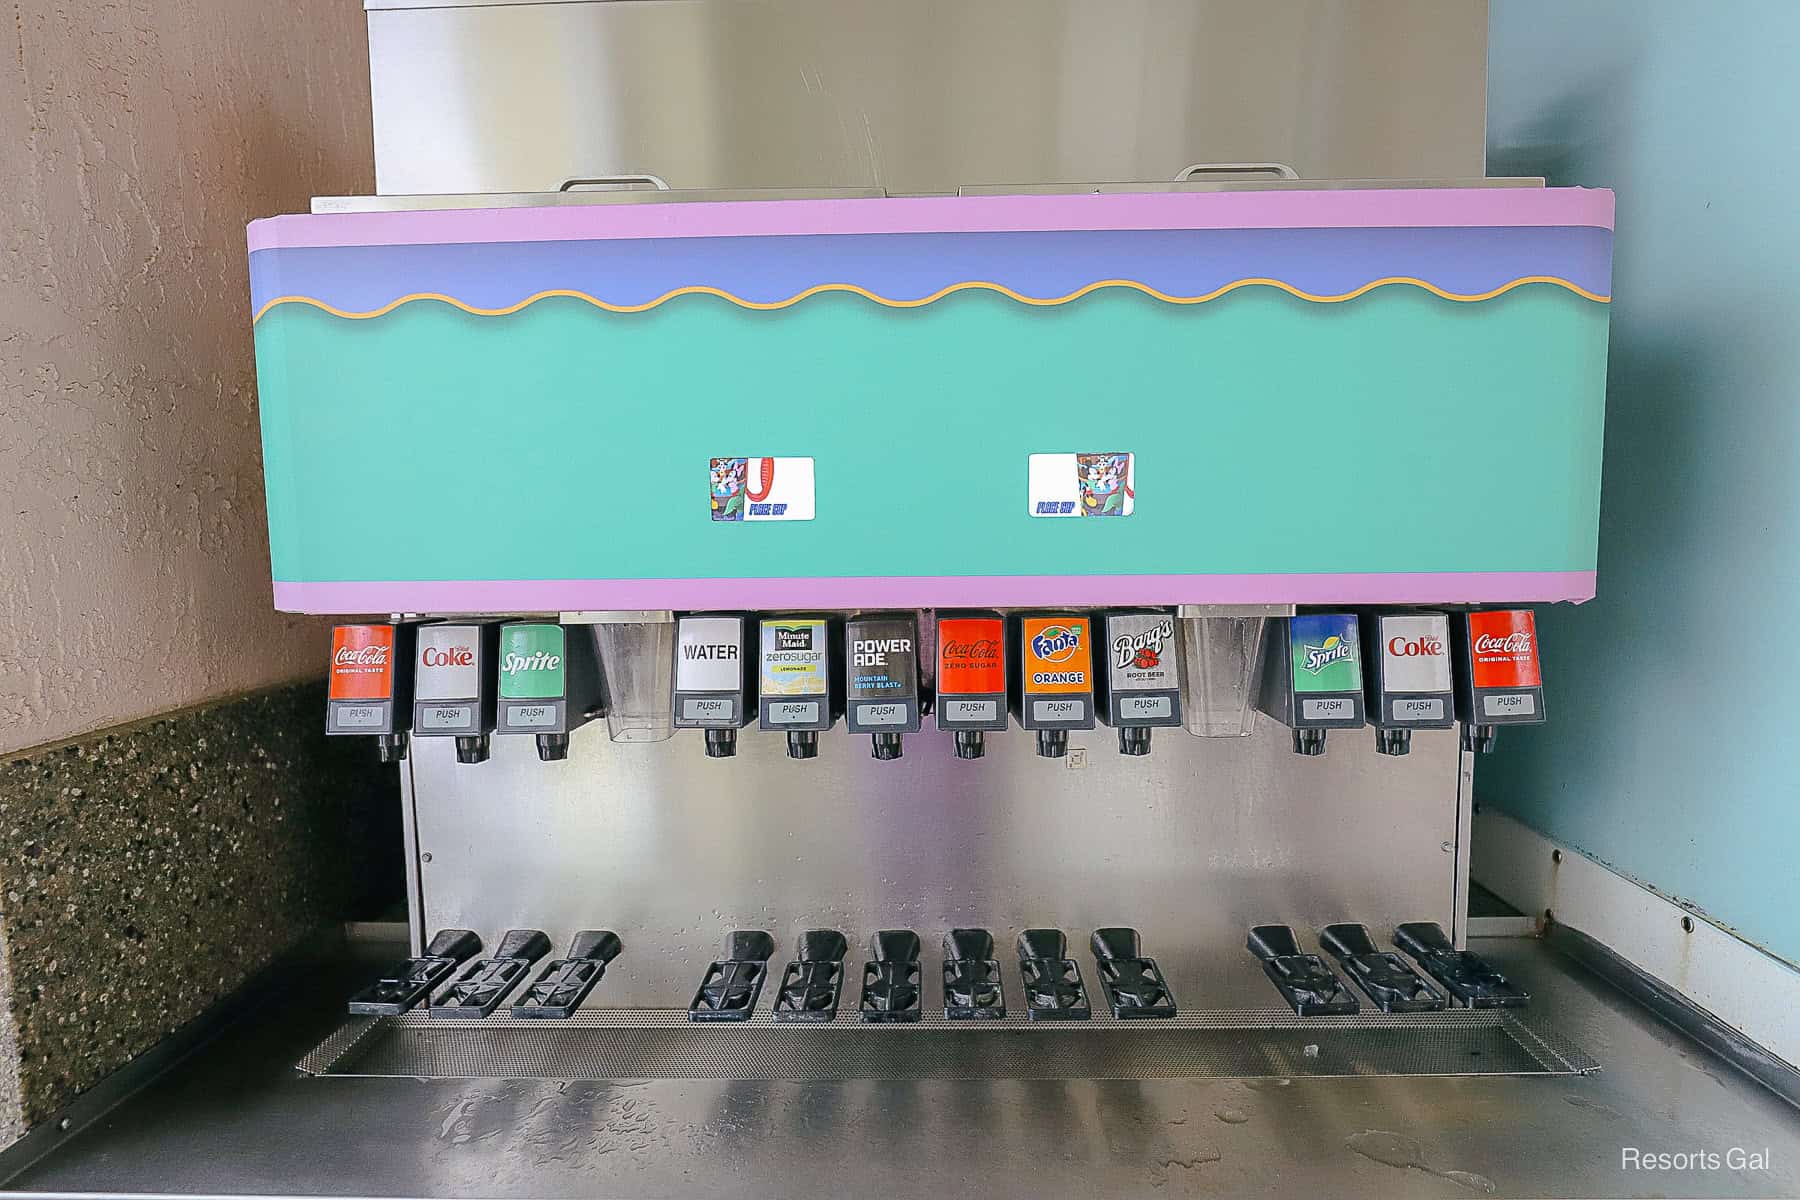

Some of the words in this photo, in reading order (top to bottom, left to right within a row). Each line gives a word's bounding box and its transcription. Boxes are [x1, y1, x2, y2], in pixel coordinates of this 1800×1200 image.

[778, 631, 809, 640] Minute
[782, 640, 806, 648] Maid
[853, 639, 911, 653] POWER
[1031, 631, 1078, 659] Fanta
[1113, 620, 1173, 669] Barq's
[1388, 636, 1442, 656] Coke
[1475, 632, 1532, 654] Coca-Cola
[422, 647, 473, 667] Coke
[684, 644, 738, 660] WATER
[1307, 644, 1349, 669] Sprite
[502, 651, 560, 675] Sprite
[853, 652, 886, 666] ADE
[1033, 672, 1084, 685] ORANGE
[696, 701, 721, 710] PUSH
[1134, 700, 1159, 709] PUSH
[1316, 701, 1342, 710] PUSH
[1406, 701, 1432, 711] PUSH
[1497, 697, 1522, 706] PUSH
[519, 707, 545, 717] PUSH
[782, 704, 807, 713] PUSH
[870, 706, 895, 715] PUSH
[959, 703, 985, 712] PUSH
[1047, 703, 1072, 712] PUSH
[436, 710, 460, 719] PUSH
